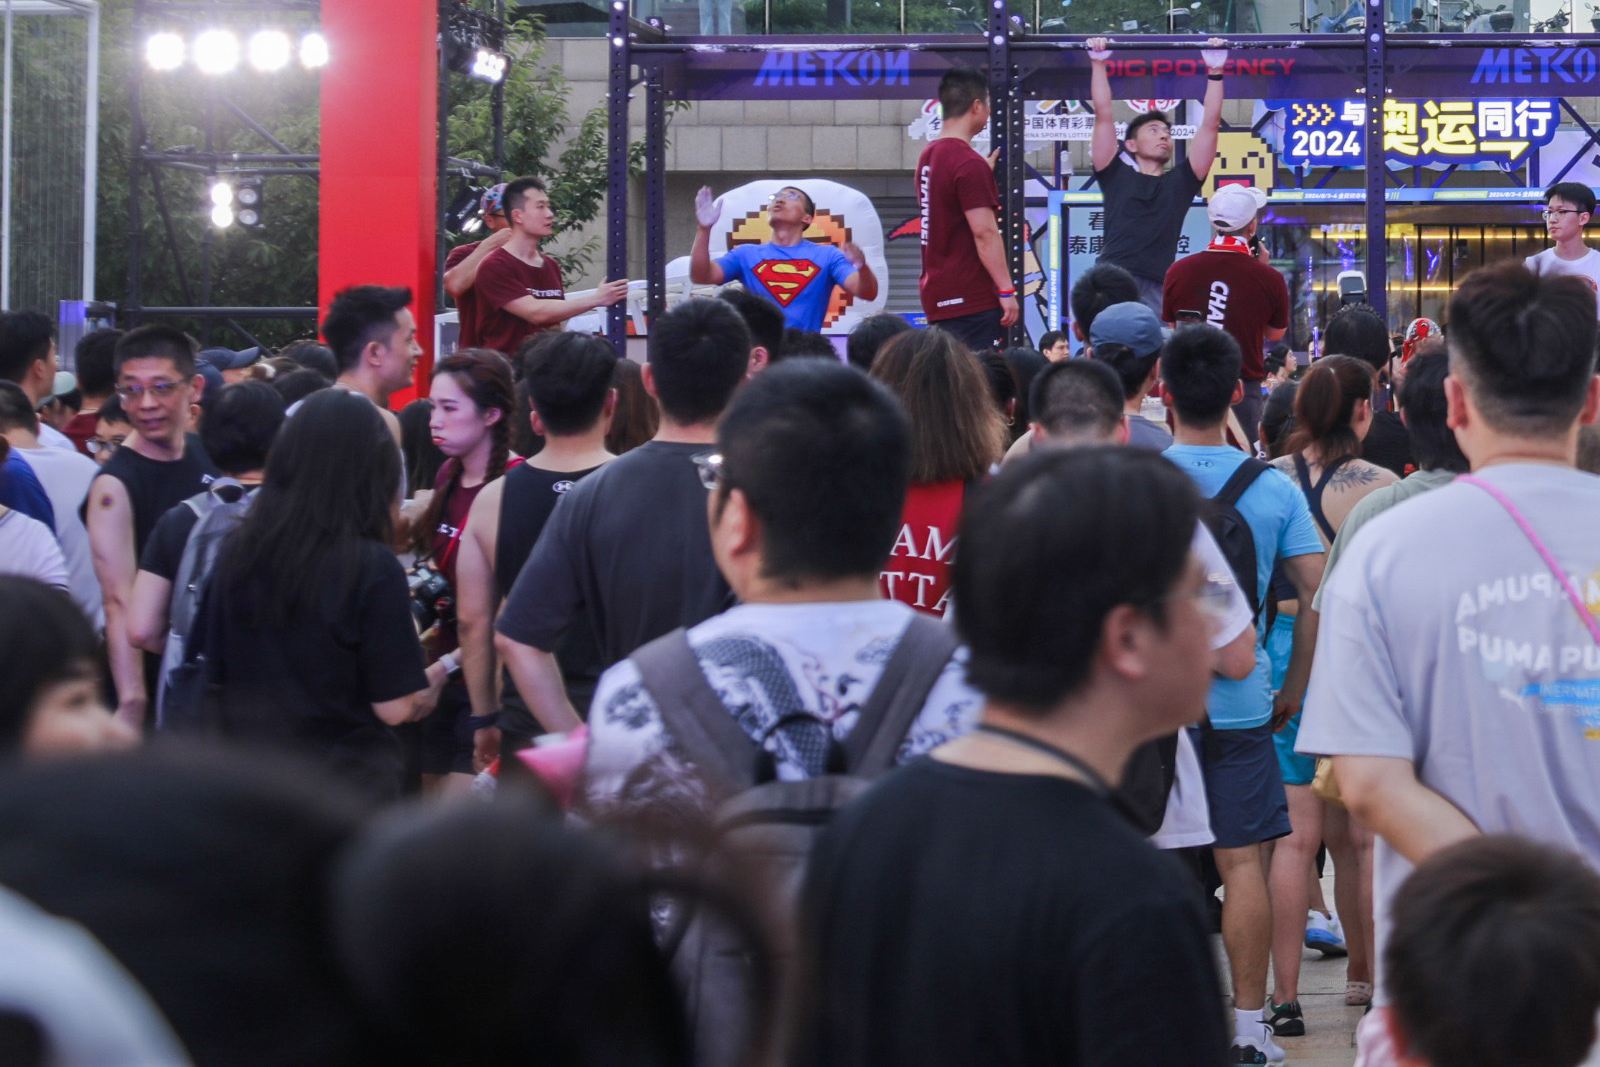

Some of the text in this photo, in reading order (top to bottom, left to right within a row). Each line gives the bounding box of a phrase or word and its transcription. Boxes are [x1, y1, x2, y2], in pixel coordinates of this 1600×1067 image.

[1152, 58, 1296, 76] POENCY
[1340, 101, 1366, 126] 与
[1170, 128, 1195, 137] 2024
[1292, 130, 1361, 156] 2024
